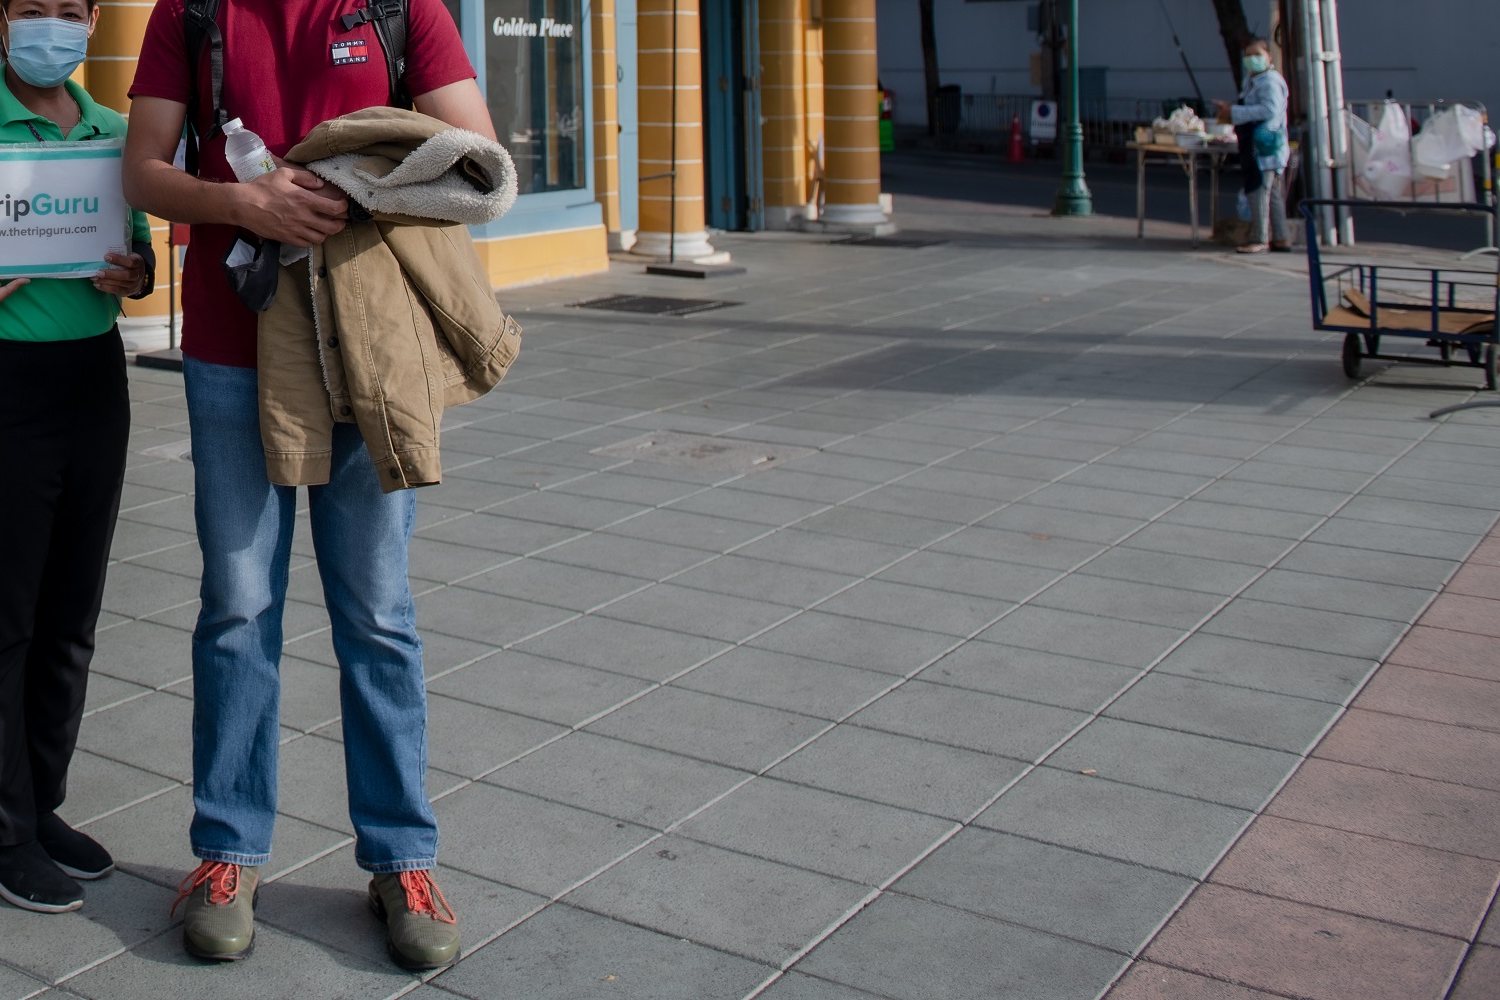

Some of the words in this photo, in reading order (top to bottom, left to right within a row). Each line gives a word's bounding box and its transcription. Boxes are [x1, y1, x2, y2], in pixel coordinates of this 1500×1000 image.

[493, 16, 537, 37] Golden
[539, 17, 574, 38] Place
[333, 40, 364, 48] TOMMY
[334, 56, 367, 64] JEANS
